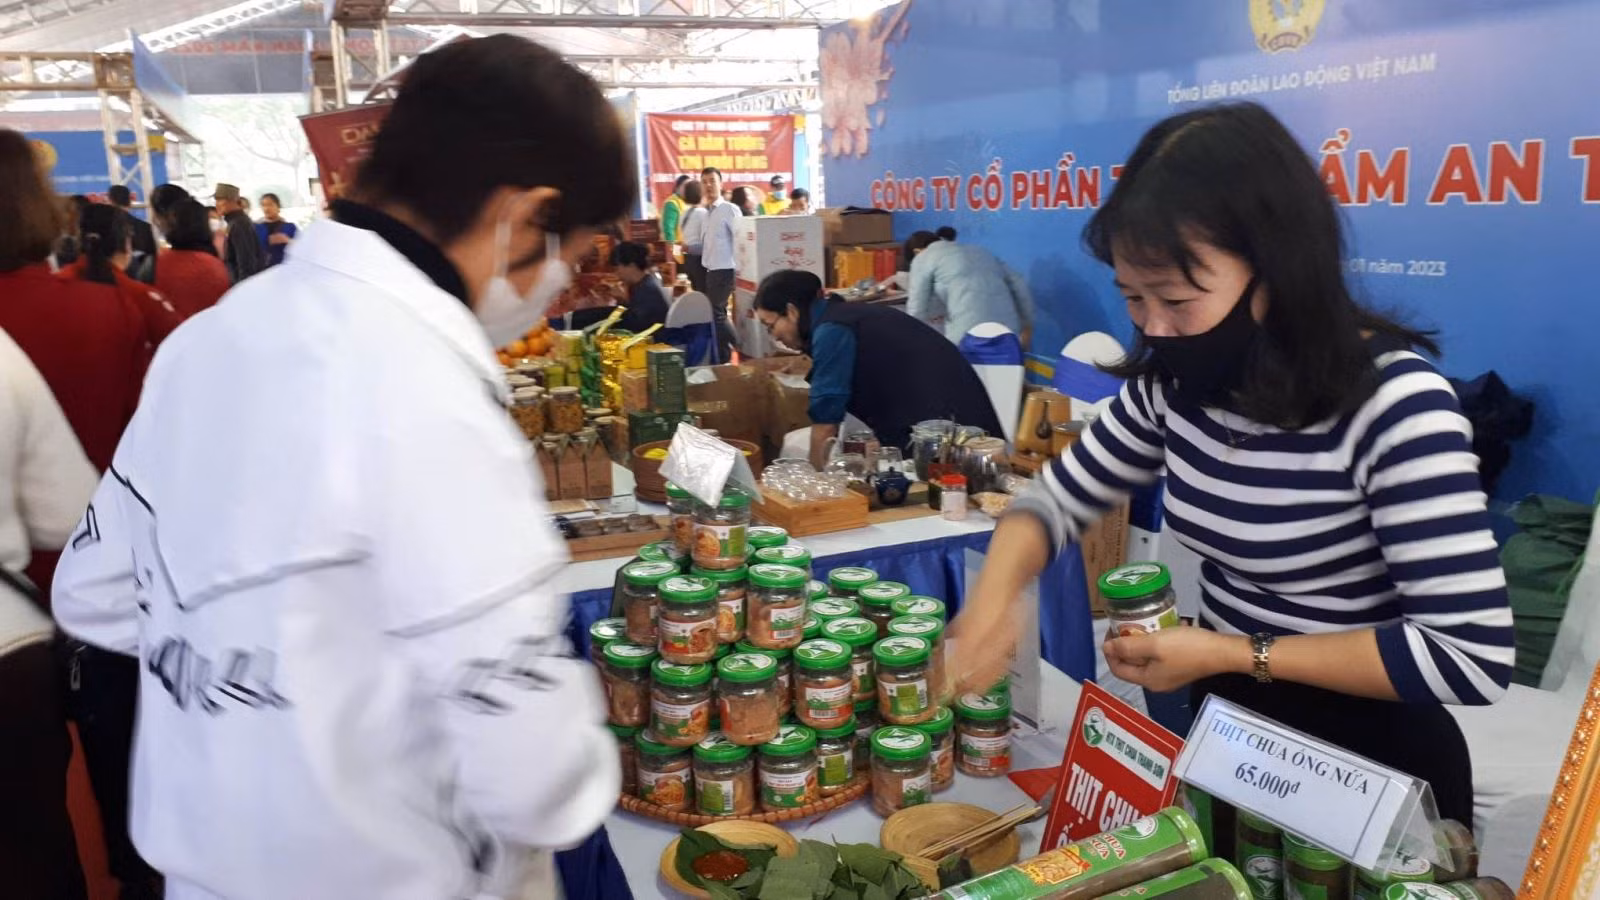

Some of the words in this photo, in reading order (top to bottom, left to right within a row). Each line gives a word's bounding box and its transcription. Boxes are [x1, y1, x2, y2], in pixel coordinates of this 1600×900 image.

[1167, 81, 1200, 104] TỔNG
[1203, 80, 1227, 99] LIÊN
[1230, 75, 1270, 97] ĐOÀN
[1273, 72, 1299, 91] LAO
[1305, 64, 1351, 90] ĐỘNG
[1356, 56, 1390, 82] VIỆT
[1393, 53, 1437, 75] NAM
[871, 170, 925, 212] CÔNG
[930, 176, 960, 211] TY
[967, 157, 1004, 212] CỔ
[1011, 152, 1100, 209] PHẦN
[1318, 128, 1410, 206] ẨM
[1426, 139, 1545, 205] AN
[1568, 136, 1600, 204] T
[1367, 258, 1404, 274] năm
[1406, 260, 1447, 277] 2023
[1212, 718, 1248, 742] THỊT
[1246, 733, 1288, 761] CHUA
[1330, 766, 1369, 795] NỨA
[1065, 763, 1103, 824] THỊT
[1099, 790, 1146, 833] CHU
[1102, 832, 1126, 860] HUA
